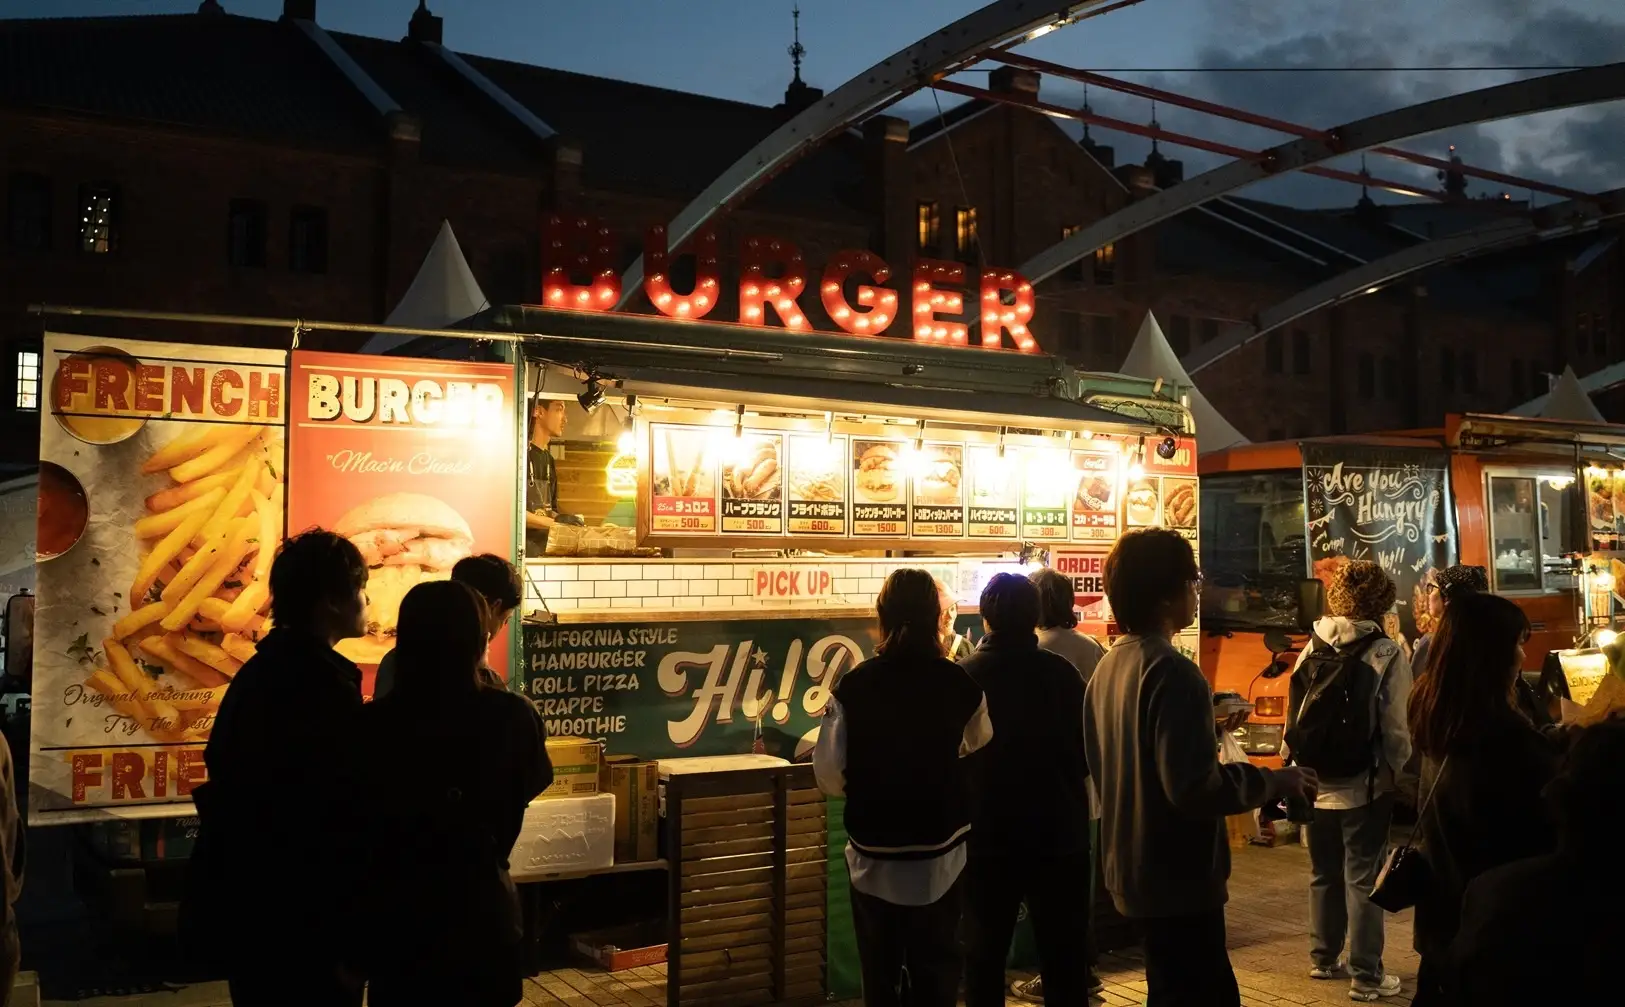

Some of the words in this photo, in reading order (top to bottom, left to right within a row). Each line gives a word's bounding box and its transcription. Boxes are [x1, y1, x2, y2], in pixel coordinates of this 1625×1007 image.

[543, 213, 1039, 354] BURGER
[57, 359, 282, 419] FRENCH
[1323, 461, 1365, 493] Are
[1369, 469, 1403, 501] you
[675, 500, 710, 513] チュロス
[791, 503, 843, 517] フライドポテト
[681, 517, 700, 528] 500
[746, 519, 765, 530] 500
[811, 520, 829, 531] 600
[877, 522, 897, 533] 1500
[934, 524, 954, 534] 1300
[1040, 527, 1054, 536] 300
[1090, 528, 1105, 538] 300
[756, 570, 799, 597] PICK
[808, 570, 830, 596] UP
[1070, 576, 1104, 593] ERE
[528, 629, 624, 649] ALIFORNIA
[627, 628, 679, 646] STYLE
[531, 650, 647, 672] HAMBURGER
[532, 675, 577, 695] ROLL
[584, 673, 640, 693] PIZZA
[63, 683, 137, 708] Original
[143, 688, 215, 705] seasoning
[533, 696, 604, 716] FRAPPE
[104, 713, 141, 736] Try
[180, 714, 217, 732] est
[543, 715, 627, 737] MOOTHIE
